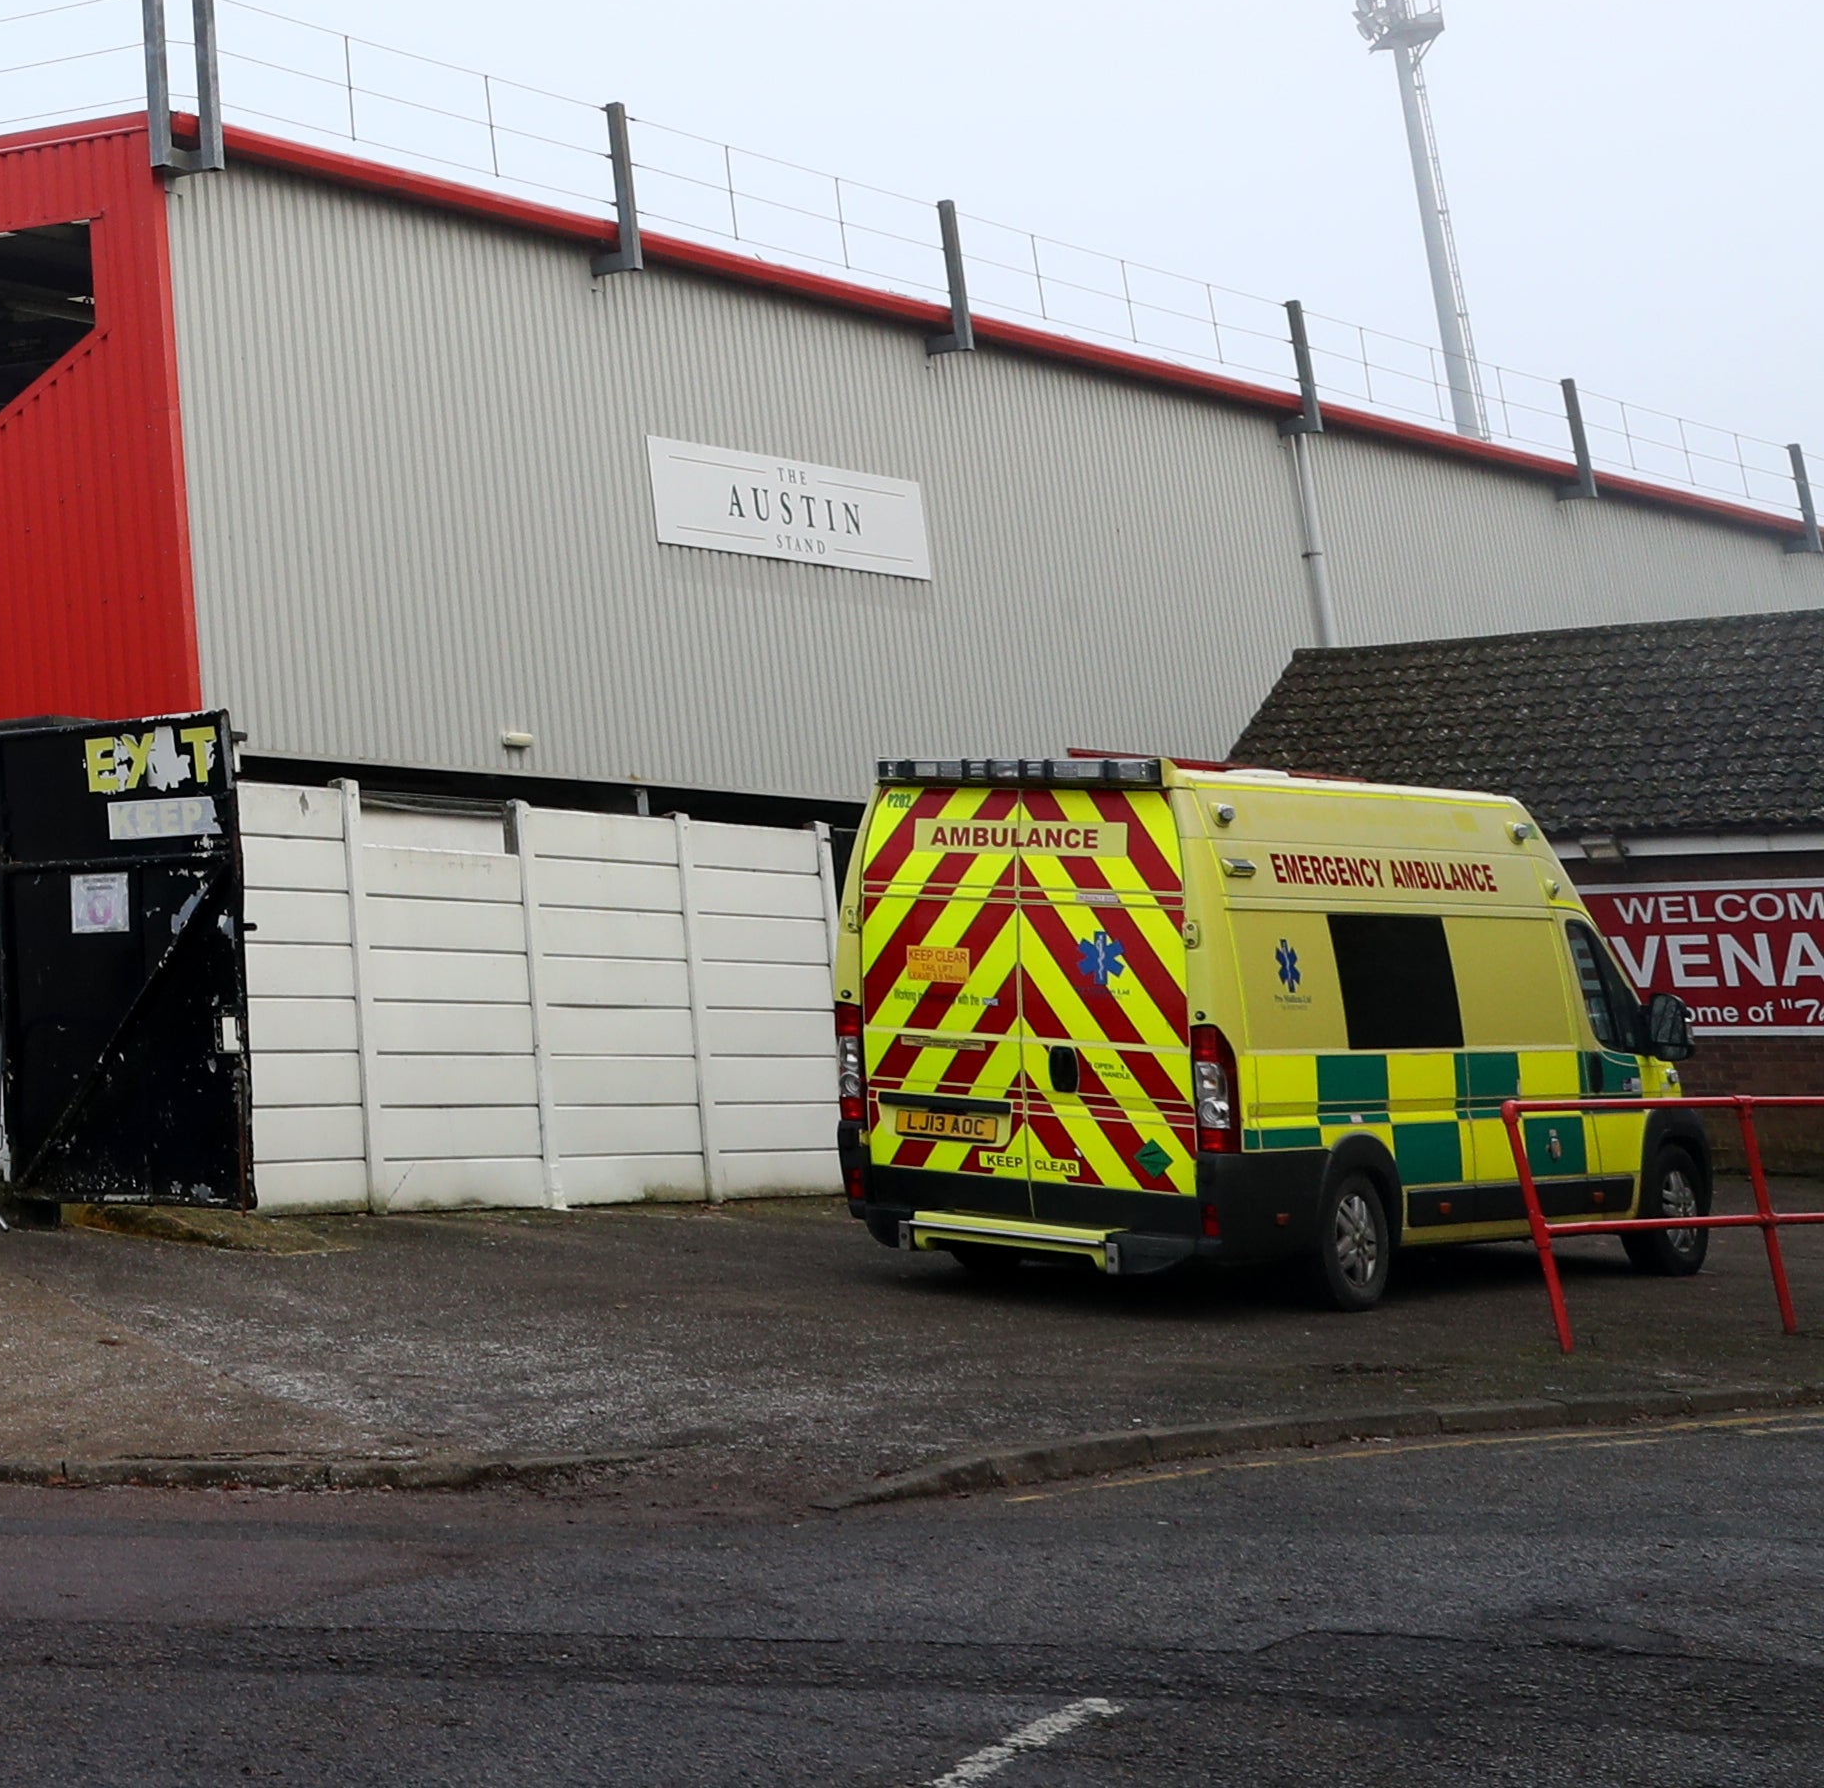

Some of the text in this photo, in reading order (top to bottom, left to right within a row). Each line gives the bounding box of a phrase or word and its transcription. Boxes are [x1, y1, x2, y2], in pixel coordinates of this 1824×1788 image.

[776, 467, 808, 486] THE
[728, 483, 862, 536] AUSTIN
[776, 534, 826, 555] STAND
[84, 726, 217, 793] EXT
[887, 792, 912, 809] P202
[110, 801, 202, 838] KEEP
[930, 826, 1099, 849] AMBULANCE
[1269, 853, 1499, 893] EMERGENCY AMBULANCE
[908, 949, 968, 964] KEEP CLEAR
[921, 963, 953, 973] TAIL LIFT
[893, 987, 917, 1003] Working
[970, 995, 980, 1005] the
[1747, 1001, 1774, 1023] of
[1094, 1062, 1114, 1071] OPEN
[907, 1113, 985, 1136] LJ13 AOC
[986, 1154, 1077, 1175] KEEP CLEAR
